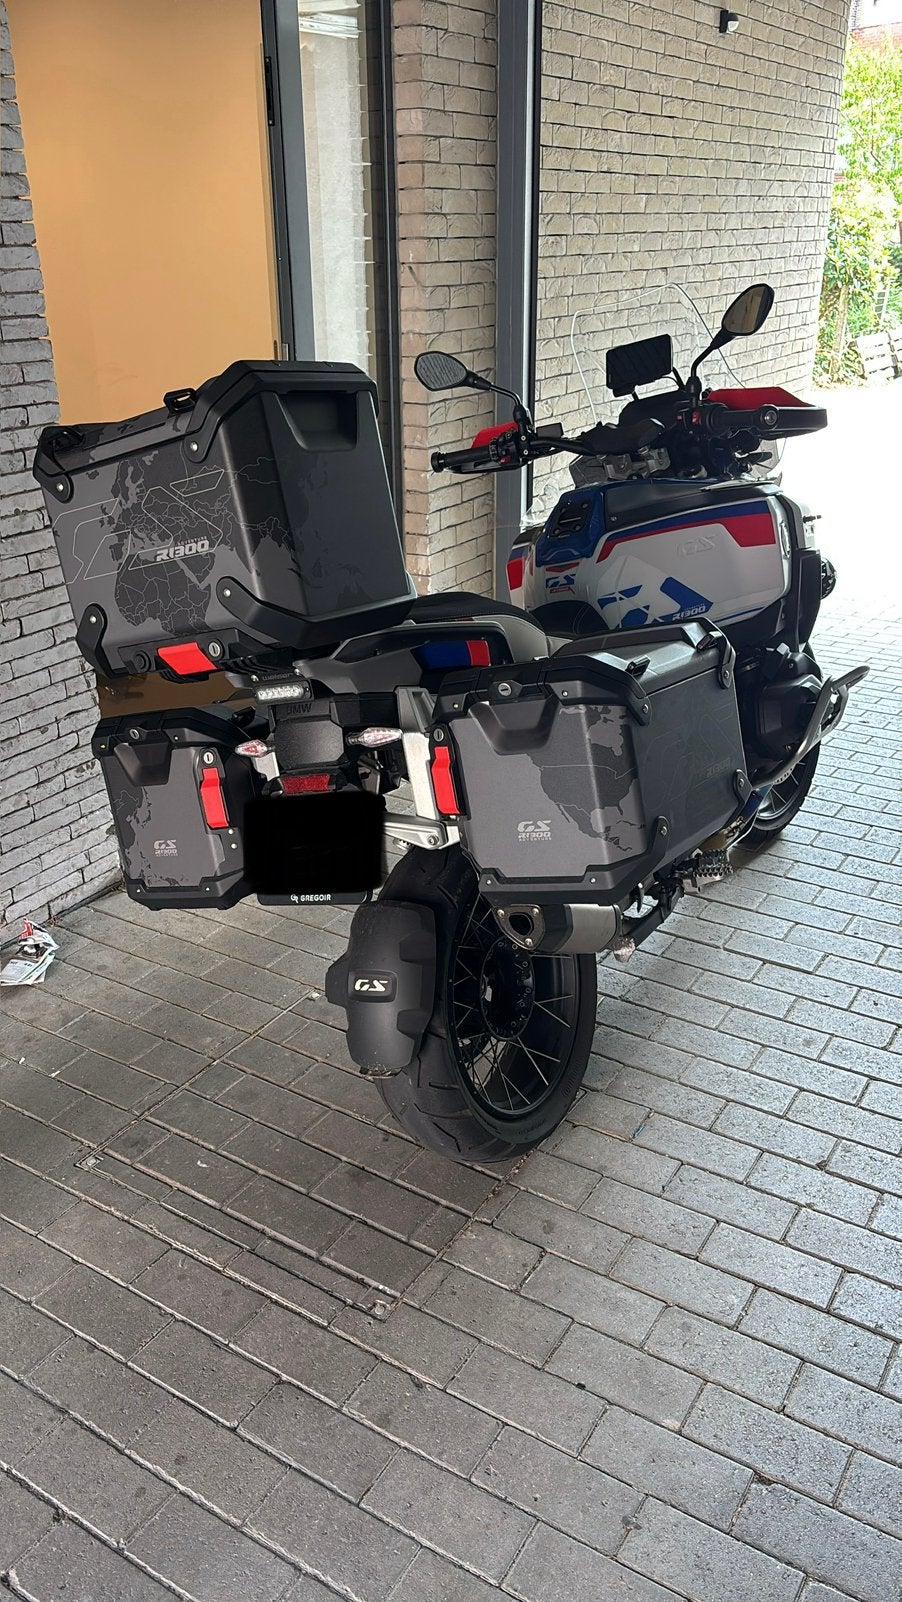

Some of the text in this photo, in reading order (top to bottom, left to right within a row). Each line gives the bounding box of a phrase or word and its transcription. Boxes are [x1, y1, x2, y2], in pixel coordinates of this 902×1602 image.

[156, 540, 210, 561] R1300
[672, 606, 706, 621] R1300
[517, 820, 551, 832] GS
[153, 839, 177, 849] GS
[354, 979, 389, 992] GS
